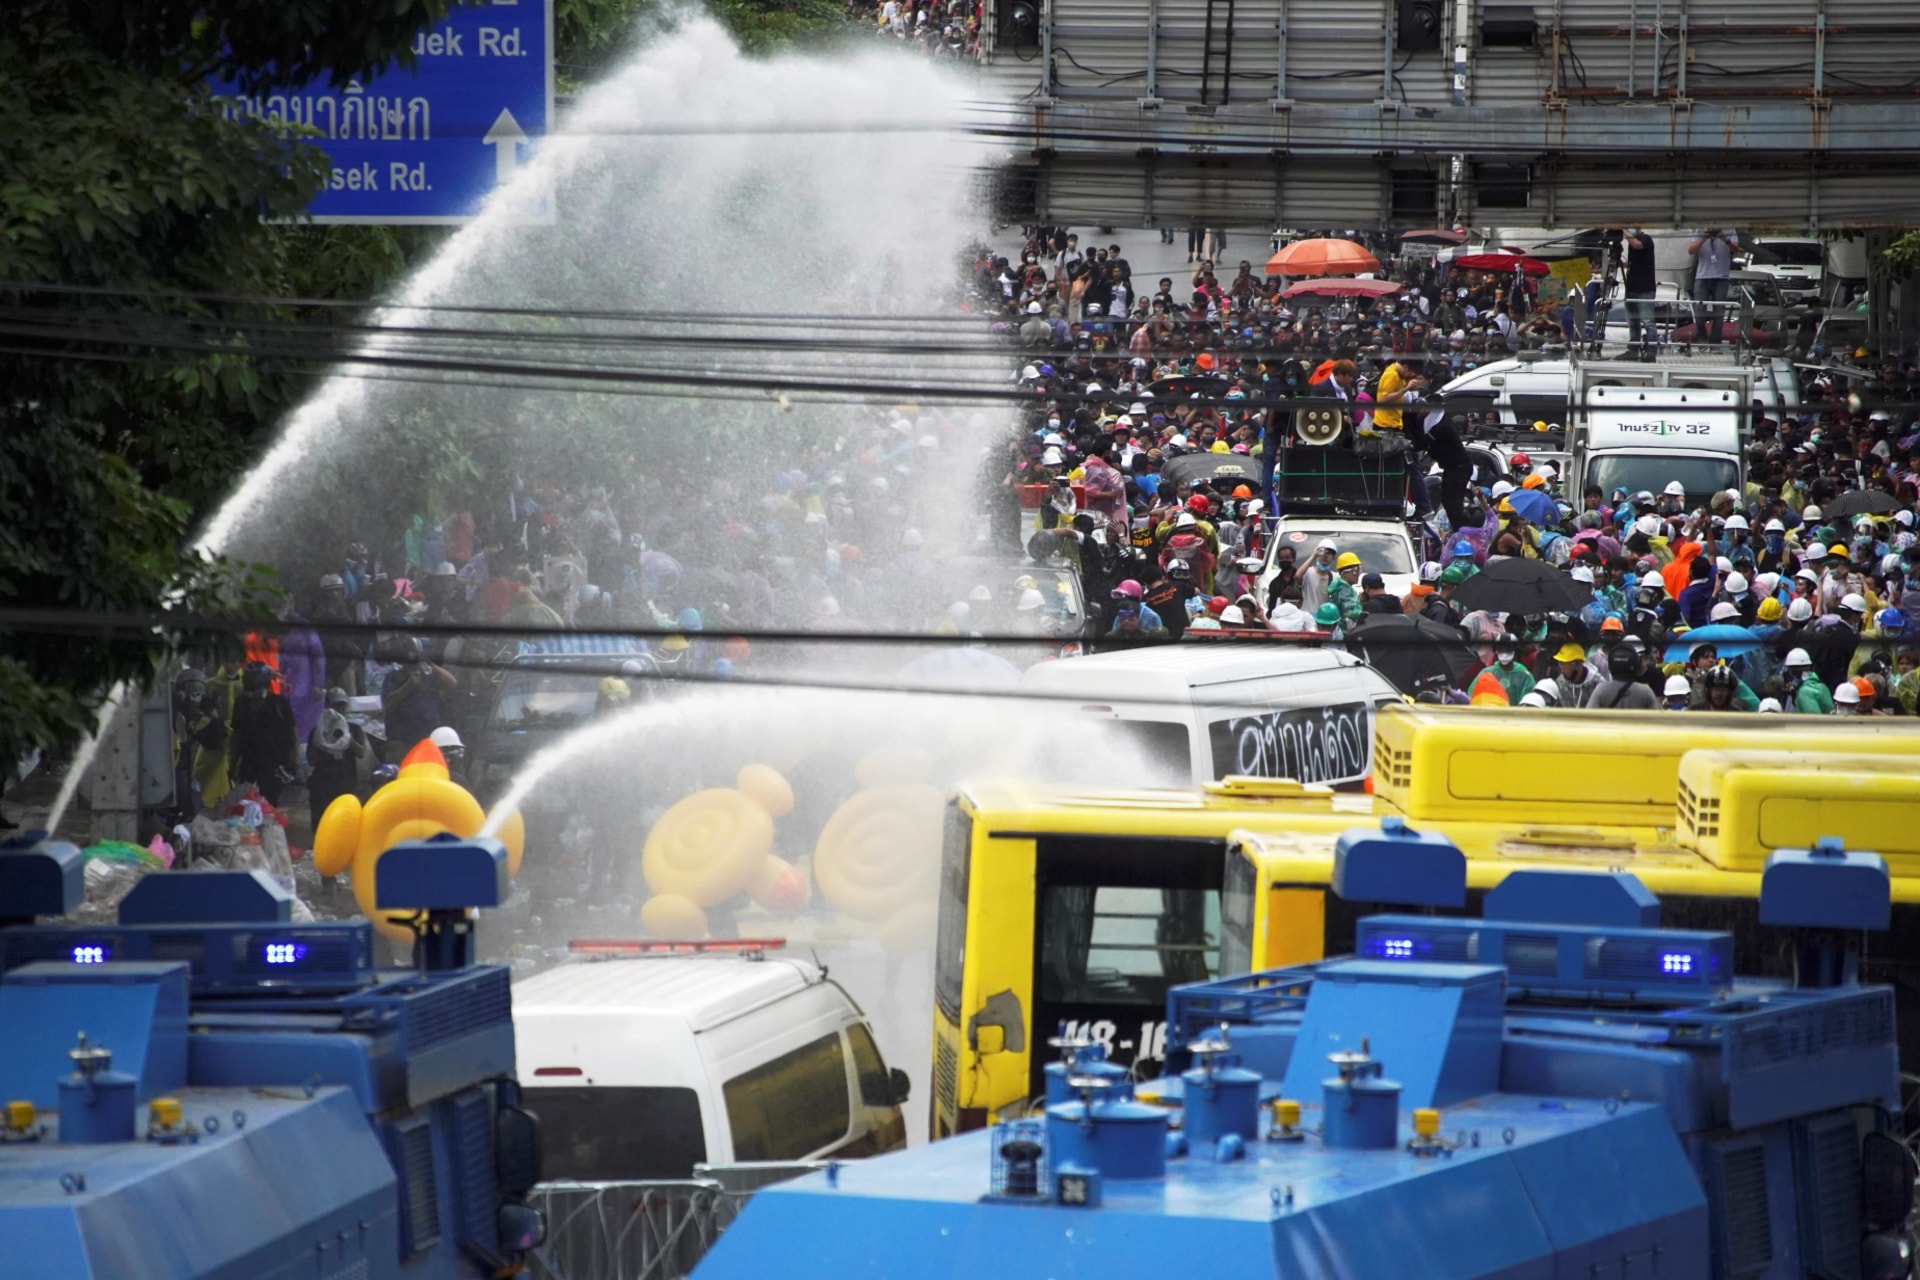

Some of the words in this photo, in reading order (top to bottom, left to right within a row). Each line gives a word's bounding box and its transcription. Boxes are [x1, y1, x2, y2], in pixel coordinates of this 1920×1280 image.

[410, 26, 463, 56] uek
[478, 27, 527, 57] Rd.
[323, 161, 378, 191] sek
[389, 161, 432, 191] Rd.
[1686, 424, 1711, 435] 32
